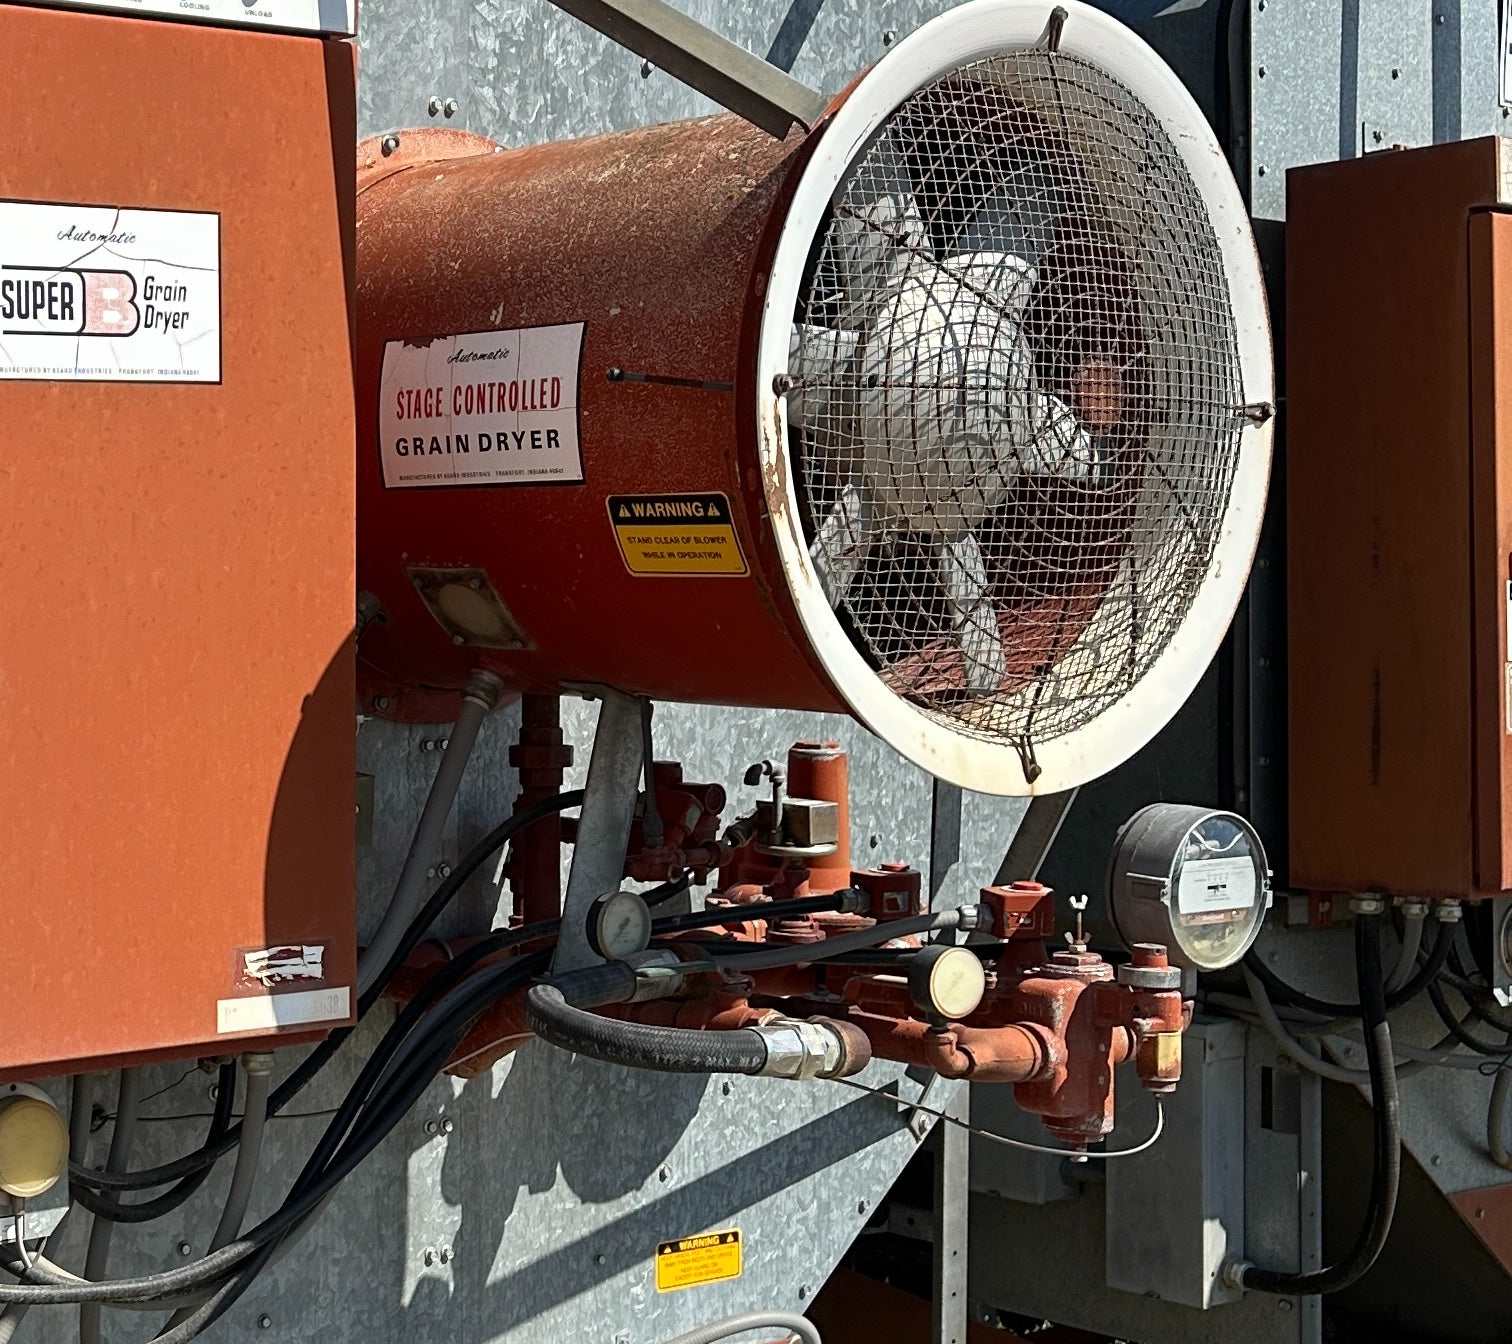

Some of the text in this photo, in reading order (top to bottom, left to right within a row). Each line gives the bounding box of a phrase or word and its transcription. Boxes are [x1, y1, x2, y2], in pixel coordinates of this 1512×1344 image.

[180, 2, 210, 10] COOLING
[245, 9, 273, 18] UNLOAD
[57, 225, 136, 244] Automatic
[143, 276, 187, 302] Grain
[2, 269, 141, 336] SUPER B
[144, 304, 189, 334] Dryer
[447, 348, 510, 364] Automatic
[396, 376, 561, 420] STAGE CONTROLLED
[395, 429, 560, 457] GRAIN DRYER
[632, 502, 704, 517] WARNING
[627, 536, 727, 544] STAND CLEAR OF BLOWER
[679, 1236, 719, 1250] WARNING
